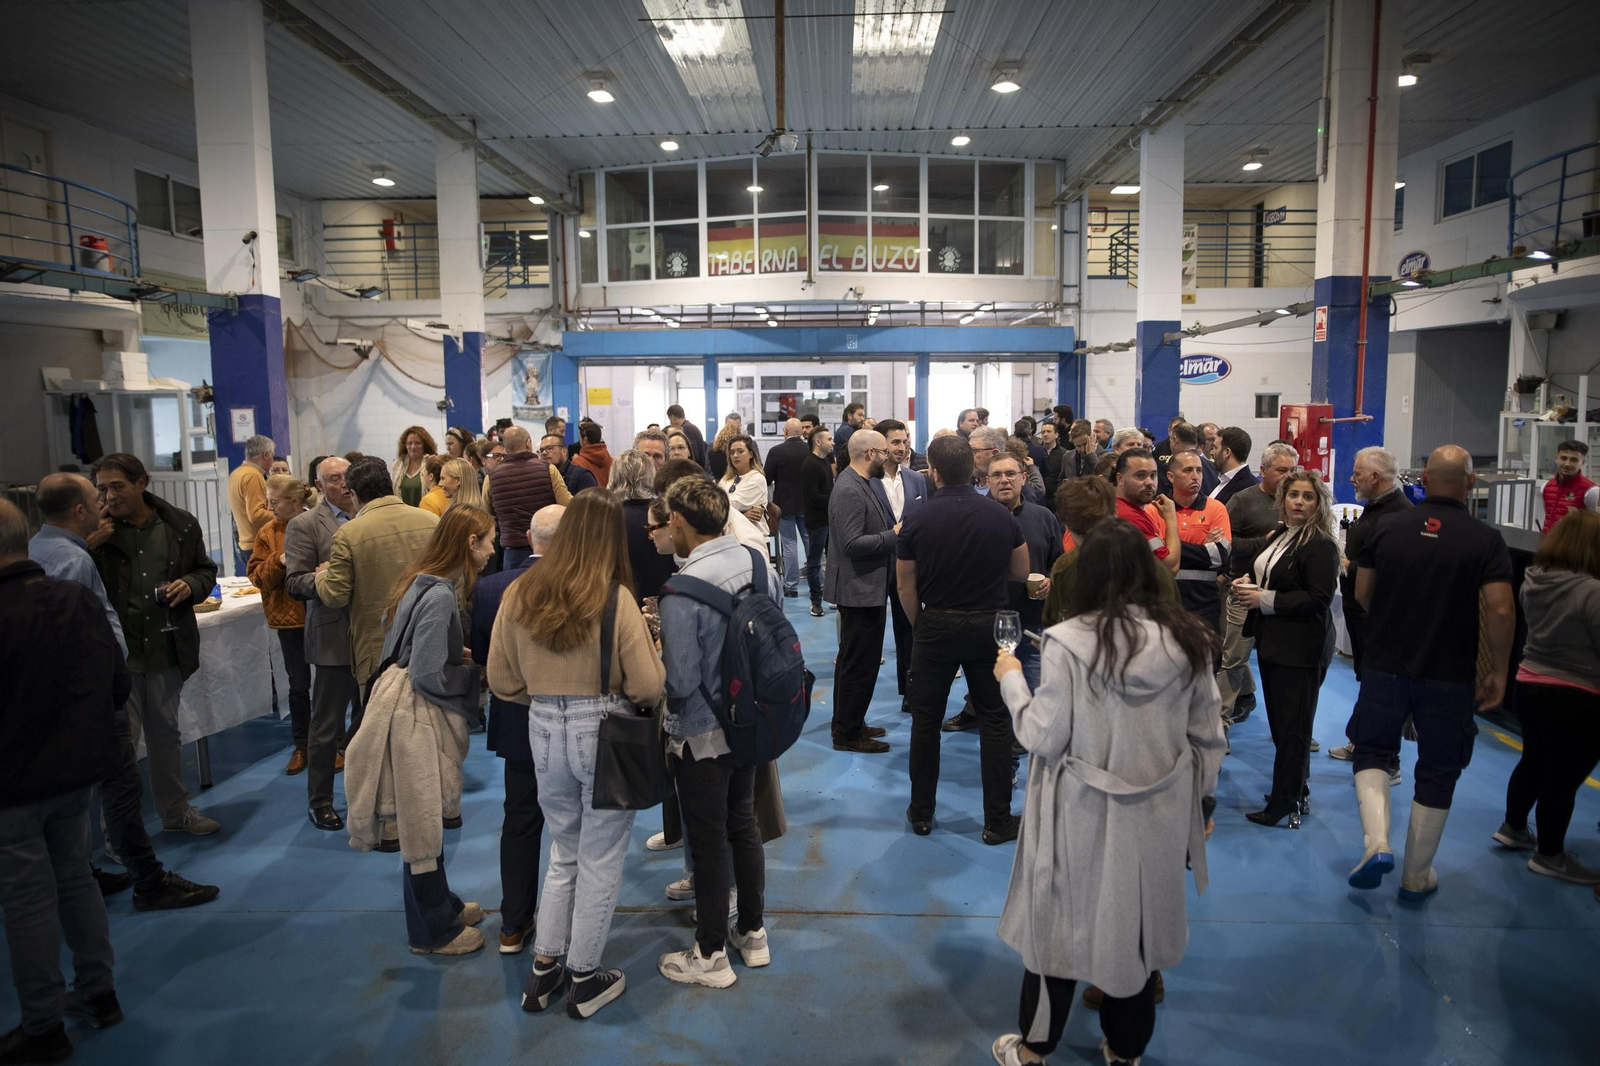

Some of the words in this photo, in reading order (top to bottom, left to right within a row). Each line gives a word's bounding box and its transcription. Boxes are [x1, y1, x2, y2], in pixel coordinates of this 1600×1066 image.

[707, 246, 798, 275] TABERNA
[818, 245, 844, 270] EL
[850, 245, 917, 270] BUZO
[939, 245, 961, 258] TABERNA
[1400, 255, 1427, 276] elmar
